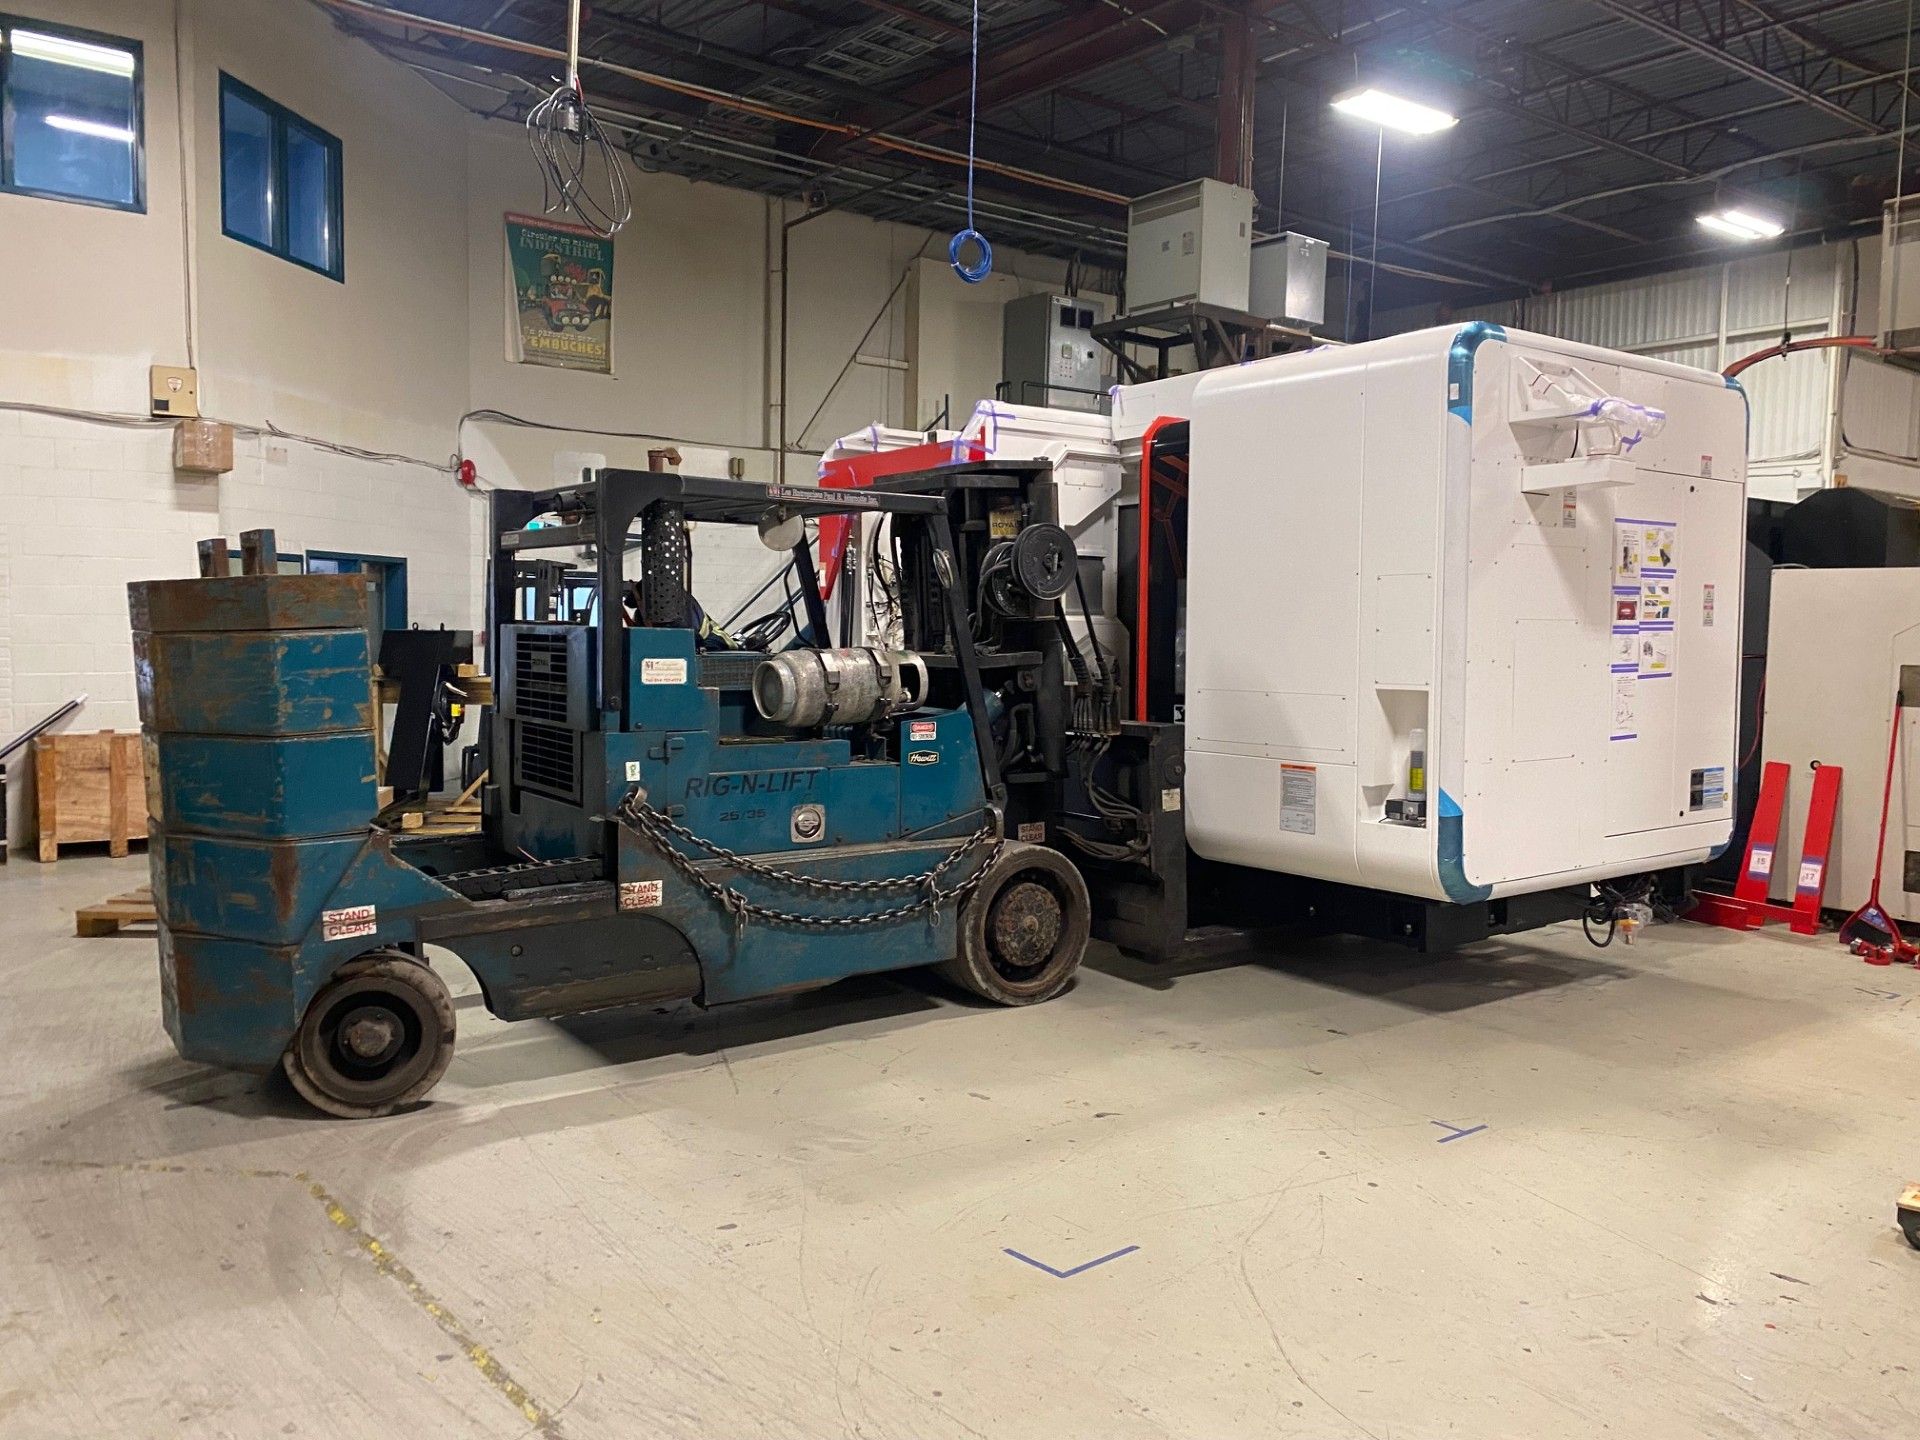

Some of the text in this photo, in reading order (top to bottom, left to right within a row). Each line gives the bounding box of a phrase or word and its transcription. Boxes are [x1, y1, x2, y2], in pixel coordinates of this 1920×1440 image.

[684, 770, 819, 799] RIG-N-LIFT
[1022, 824, 1043, 833] STAND
[1021, 832, 1043, 842] CLEAR
[624, 883, 657, 894] STAND
[624, 895, 657, 906] CLEAR
[328, 910, 370, 923] STAND
[328, 924, 372, 937] CLEAR
